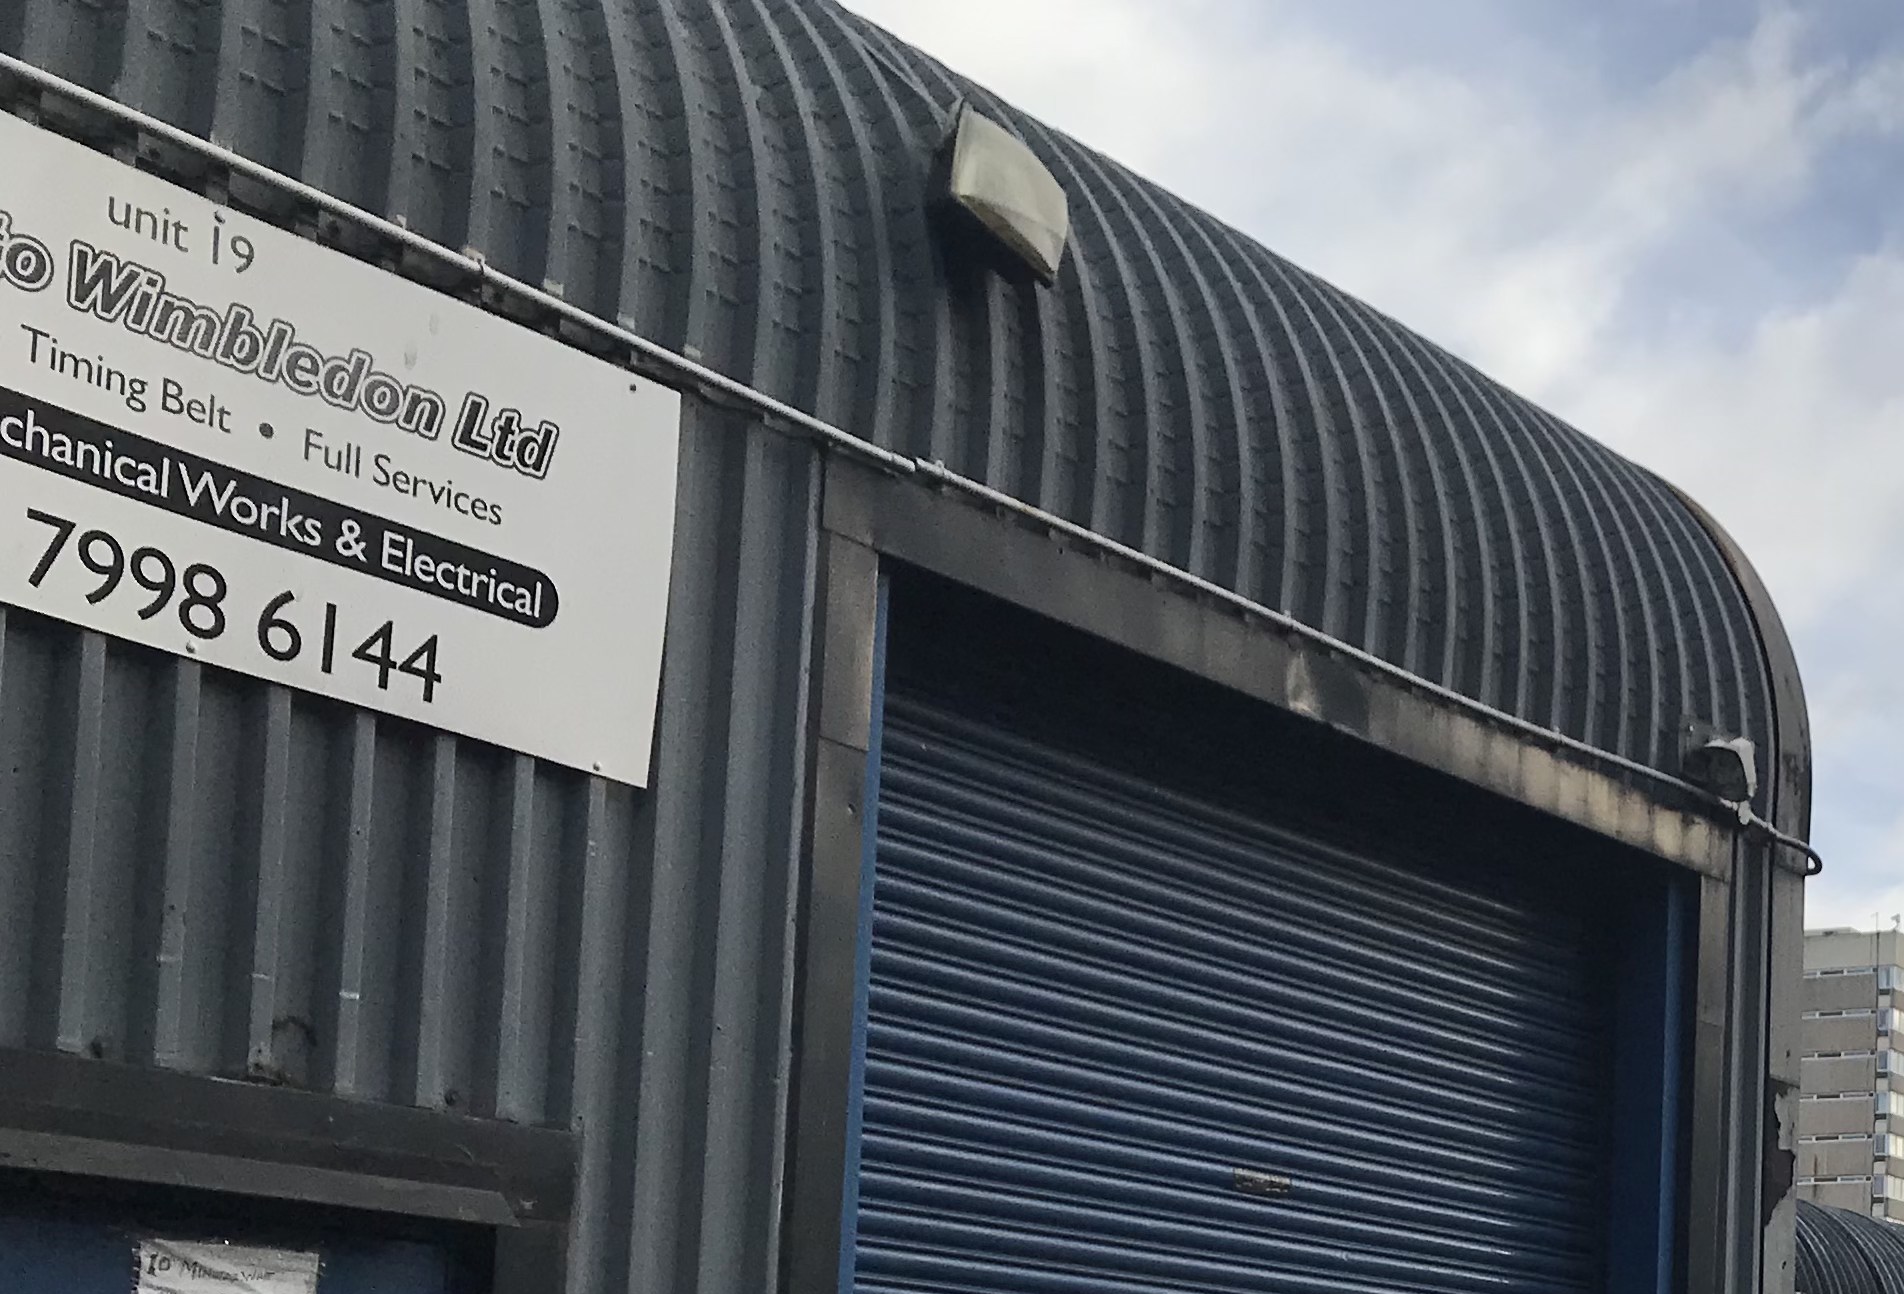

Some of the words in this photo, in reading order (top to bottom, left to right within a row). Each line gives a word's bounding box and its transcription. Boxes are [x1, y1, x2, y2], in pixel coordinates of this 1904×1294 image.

[108, 196, 189, 253] unit
[211, 215, 256, 274] 19
[21, 324, 147, 413] Timing
[161, 377, 232, 434] Belt
[304, 429, 361, 478] Full
[373, 455, 503, 525] Services
[67, 240, 446, 440] Wimbledon
[451, 391, 559, 479] Ltd
[1, 409, 169, 498] chanical
[179, 462, 322, 547] Works
[335, 519, 368, 562] &
[382, 531, 542, 619] Electrical
[26, 507, 227, 640] 7998
[257, 590, 443, 704] 6144
